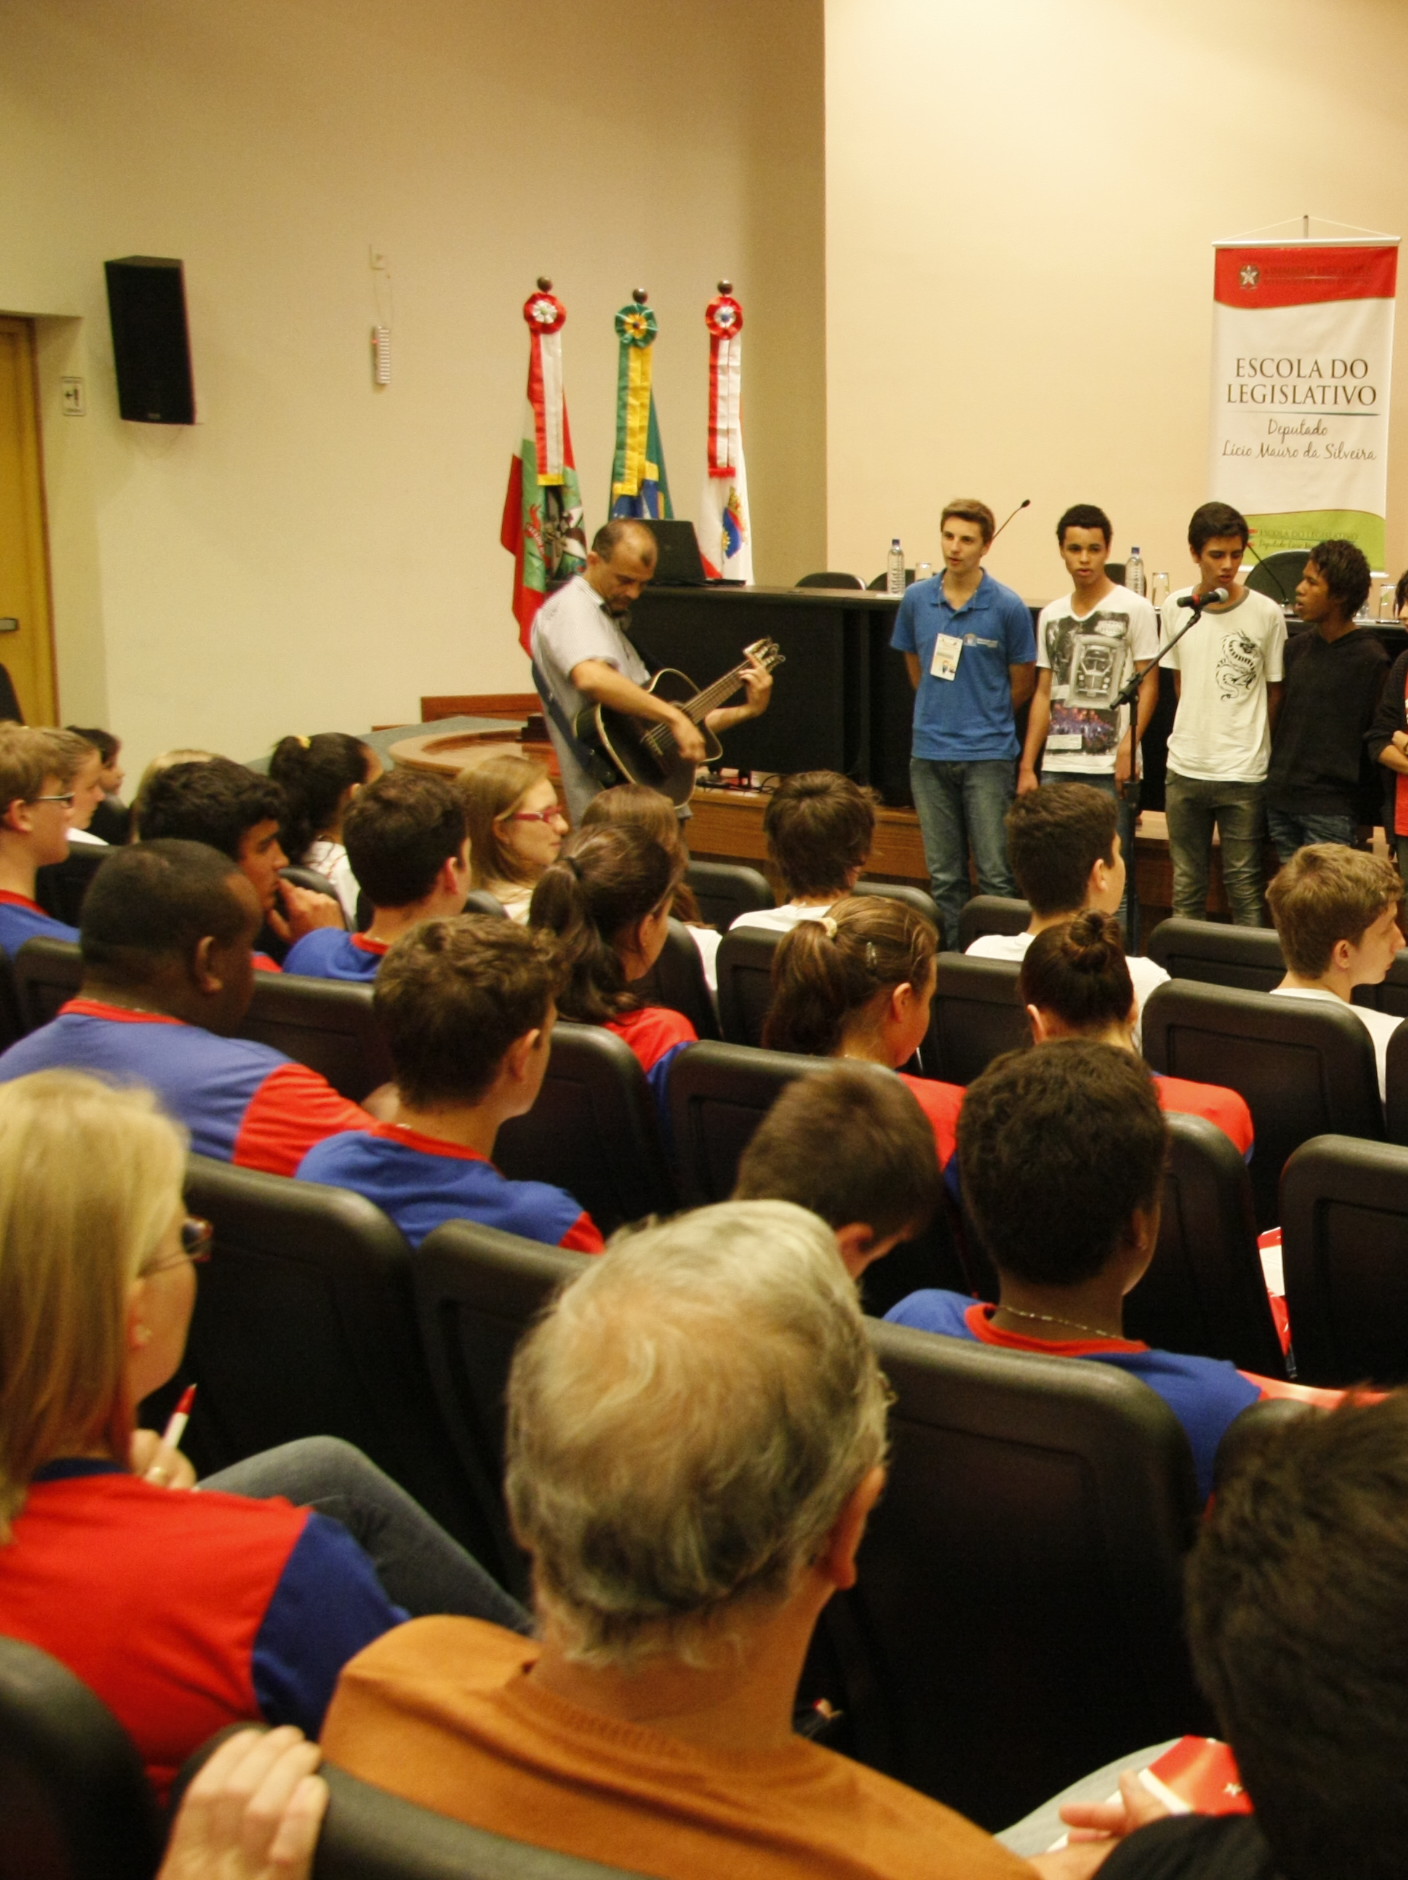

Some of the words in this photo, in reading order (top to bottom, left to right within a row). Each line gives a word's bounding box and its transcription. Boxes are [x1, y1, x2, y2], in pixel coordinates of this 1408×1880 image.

[1236, 358, 1323, 379] ESCOLA
[1330, 358, 1369, 379] DO
[1226, 384, 1377, 406] LEGISLATIVO
[1267, 419, 1328, 444] Deputado
[1256, 443, 1299, 459] Mauro
[1303, 442, 1320, 459] da
[1323, 442, 1376, 461] Silveira
